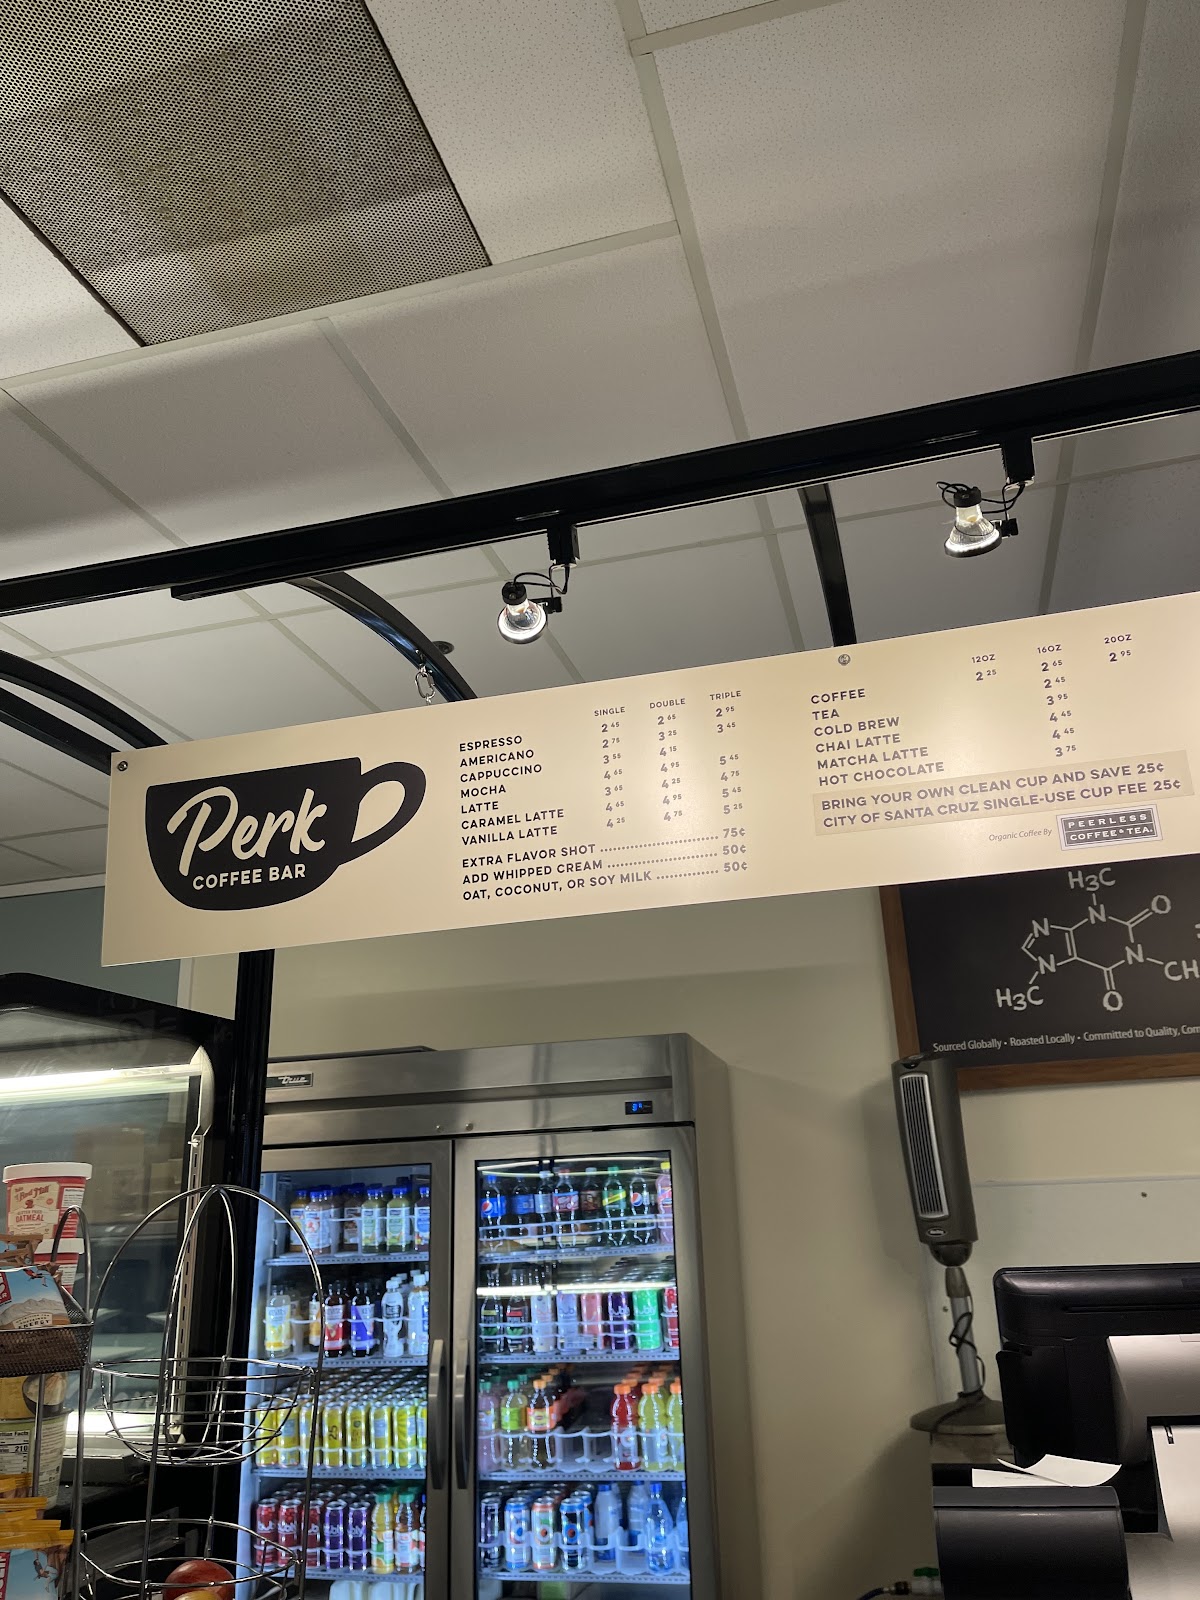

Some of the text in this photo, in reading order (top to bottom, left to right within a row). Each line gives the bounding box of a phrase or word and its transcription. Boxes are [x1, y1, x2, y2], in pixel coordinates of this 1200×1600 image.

[1105, 635, 1131, 643] 20OZ
[1038, 645, 1061, 653] 16OZ
[972, 655, 995, 663] 12OZ
[650, 698, 685, 708] DOUBLE
[710, 691, 741, 700] TRIPLE
[811, 689, 865, 703] COFFEE
[595, 707, 625, 716] SINGLE
[812, 709, 839, 720] TEA
[814, 717, 899, 736] COLD BREW
[460, 736, 522, 751] ESPRESSO
[816, 734, 900, 752] CHAI LATTE
[460, 750, 533, 767] AMERICANO
[818, 747, 928, 769] MATCHA LATTE
[461, 765, 541, 782] CAPPUCCINO
[820, 762, 944, 786] HOT CHOCOLATE
[461, 785, 506, 798] MOCHA
[822, 763, 1163, 810] BRING YOUR OWN CLEAN CUP AND SAVE 25¢
[462, 801, 498, 813] LATTE
[824, 780, 1180, 827] CITY OF SANTA CRUZ SINGLE-USE CUP FEE 25¢
[462, 809, 563, 829] CARAMEL LATTE
[1068, 814, 1147, 829] PEERLESS
[167, 786, 328, 877] Perk
[462, 826, 557, 845] VANILLA LATTE
[723, 828, 745, 838] 75¢
[989, 832, 1017, 841] Organic
[1070, 830, 1118, 841] COFFEE
[463, 844, 595, 867] EXTRA FLAVOR SHOT
[723, 845, 746, 854] 50¢
[463, 860, 601, 884] ADD WHIPPED CREAM
[724, 862, 747, 872] 50¢
[192, 864, 306, 890] COFFEE BAR
[463, 871, 651, 900] OAT, COCONUT, OR SOY MILK
[1151, 895, 1171, 914] O
[1088, 904, 1107, 924] N
[1032, 918, 1050, 937] N
[1125, 944, 1144, 964] N
[1038, 954, 1056, 974] N
[1103, 991, 1123, 1011] O
[933, 1040, 966, 1052] Sourced
[968, 1039, 1001, 1050] Globally
[1009, 1035, 1044, 1046] Roasted
[1045, 1032, 1075, 1044] Locally
[1083, 1029, 1133, 1041] Committed
[1134, 1029, 1144, 1038] to
[1145, 1026, 1180, 1037] Quality,
[16, 1214, 44, 1223] OATMEAL
